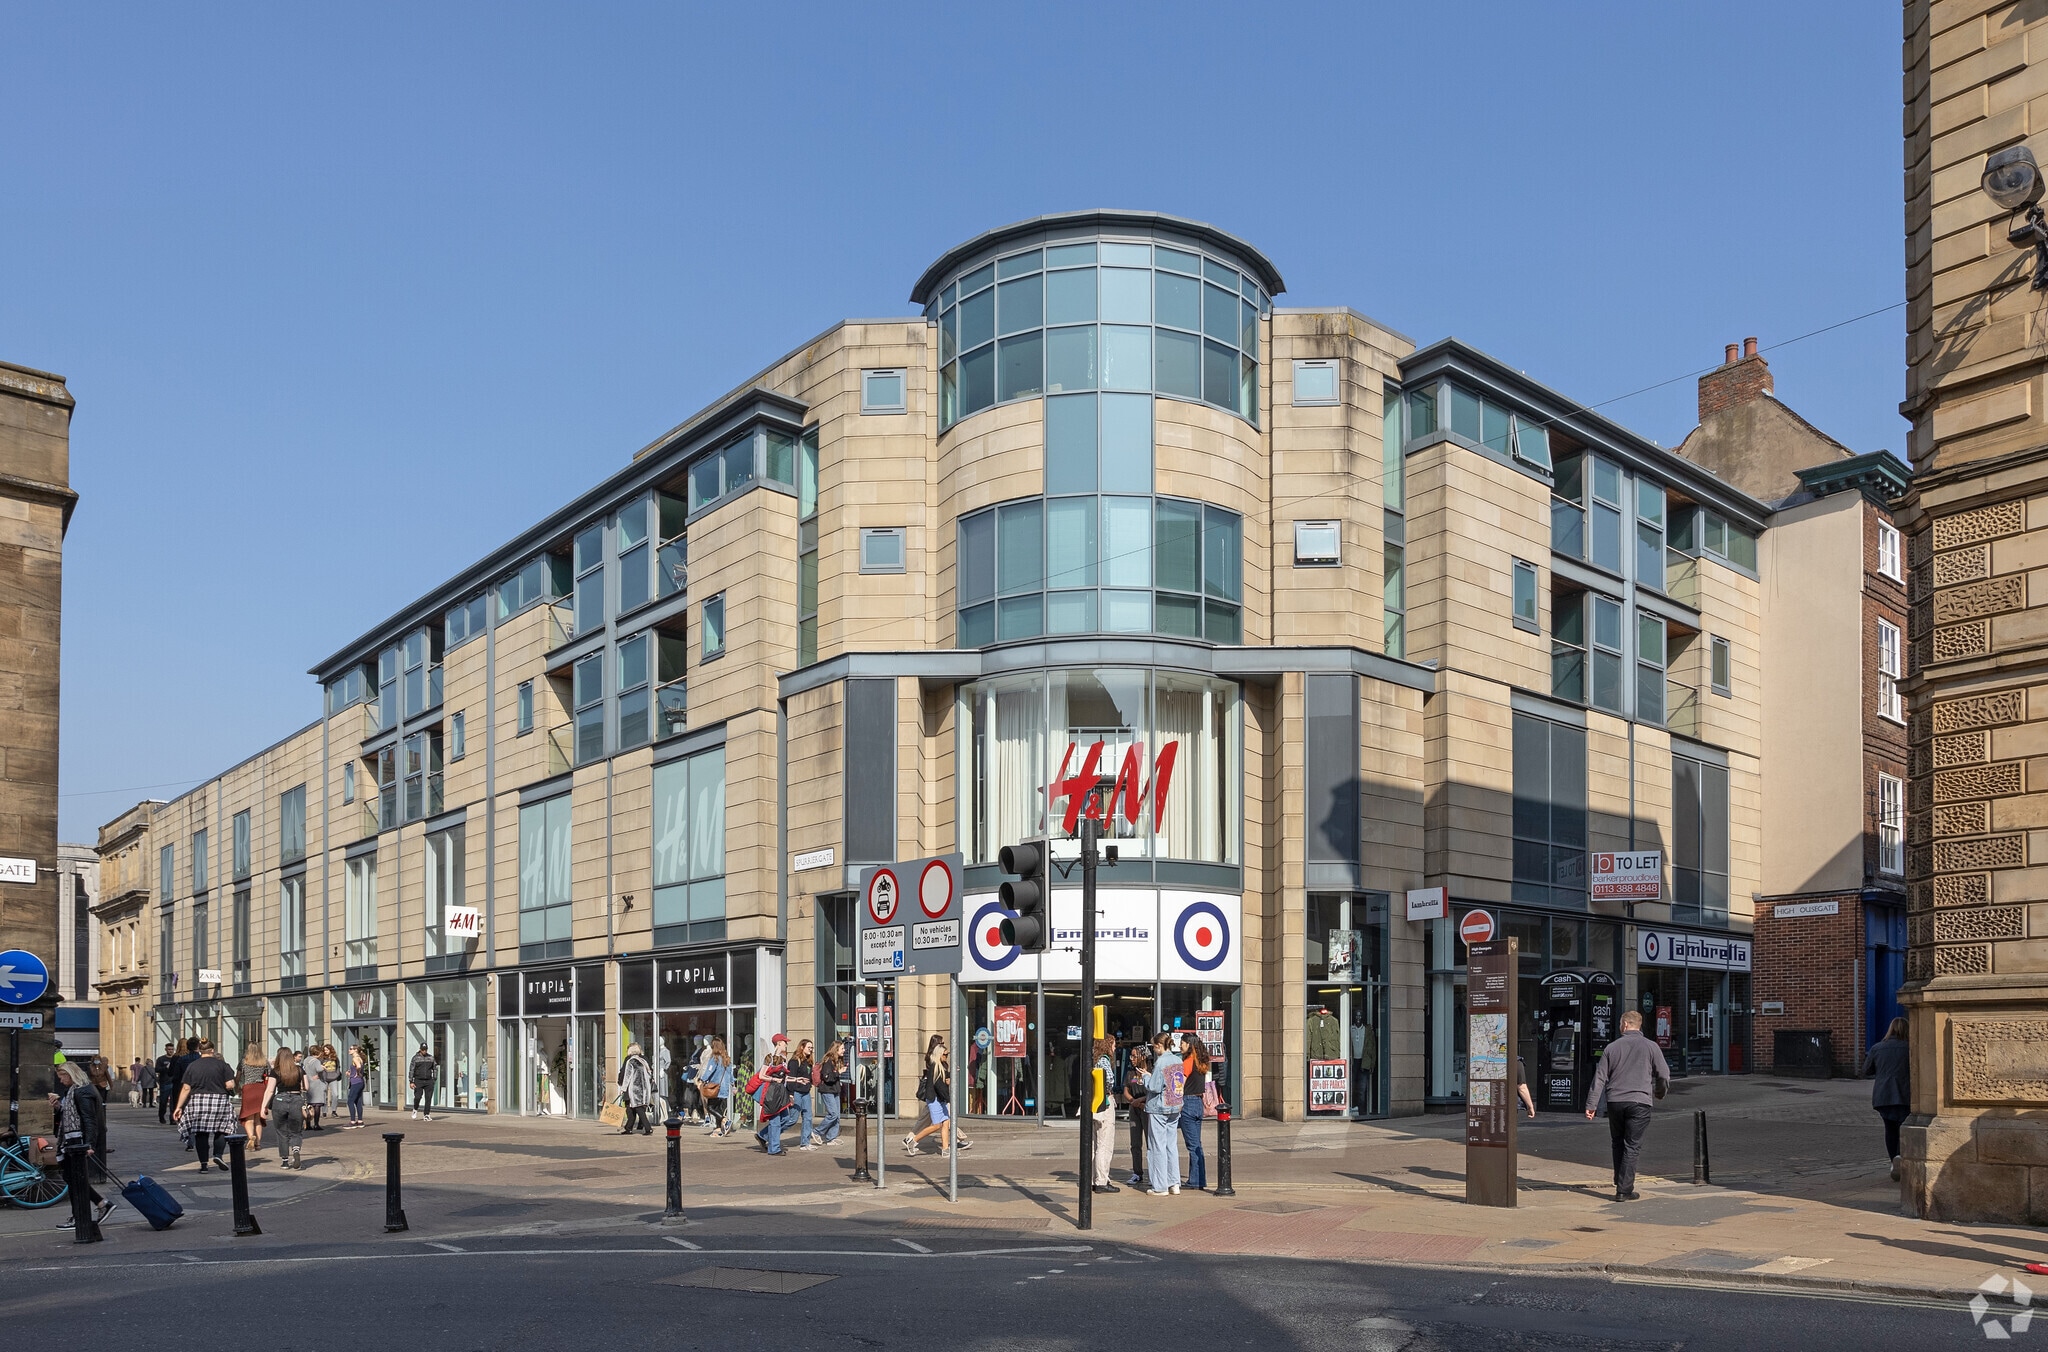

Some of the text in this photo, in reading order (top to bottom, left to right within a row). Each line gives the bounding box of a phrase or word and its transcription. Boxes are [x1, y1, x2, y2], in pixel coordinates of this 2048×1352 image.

[1037, 741, 1178, 835] H&M
[1616, 856, 1658, 869] TO LET
[1593, 873, 1659, 883] barkerproudlove
[1594, 884, 1658, 893] 0113 388 4848
[1800, 904, 1836, 913] OUSEGATE
[450, 913, 475, 930] H&M
[920, 925, 952, 935] No vehicles
[914, 936, 931, 945] 10.30
[1667, 936, 1746, 962] Lambretta
[864, 956, 893, 966] loading and
[666, 967, 716, 984] UTOPIA
[1553, 974, 1572, 983] cash
[528, 979, 565, 994] UTOPIA
[694, 986, 725, 994] WOMENSWEAR
[1593, 1004, 1611, 1016] cash
[18, 1016, 39, 1025] Left
[997, 1020, 1024, 1042] 60%
[1551, 1077, 1571, 1086] cash
